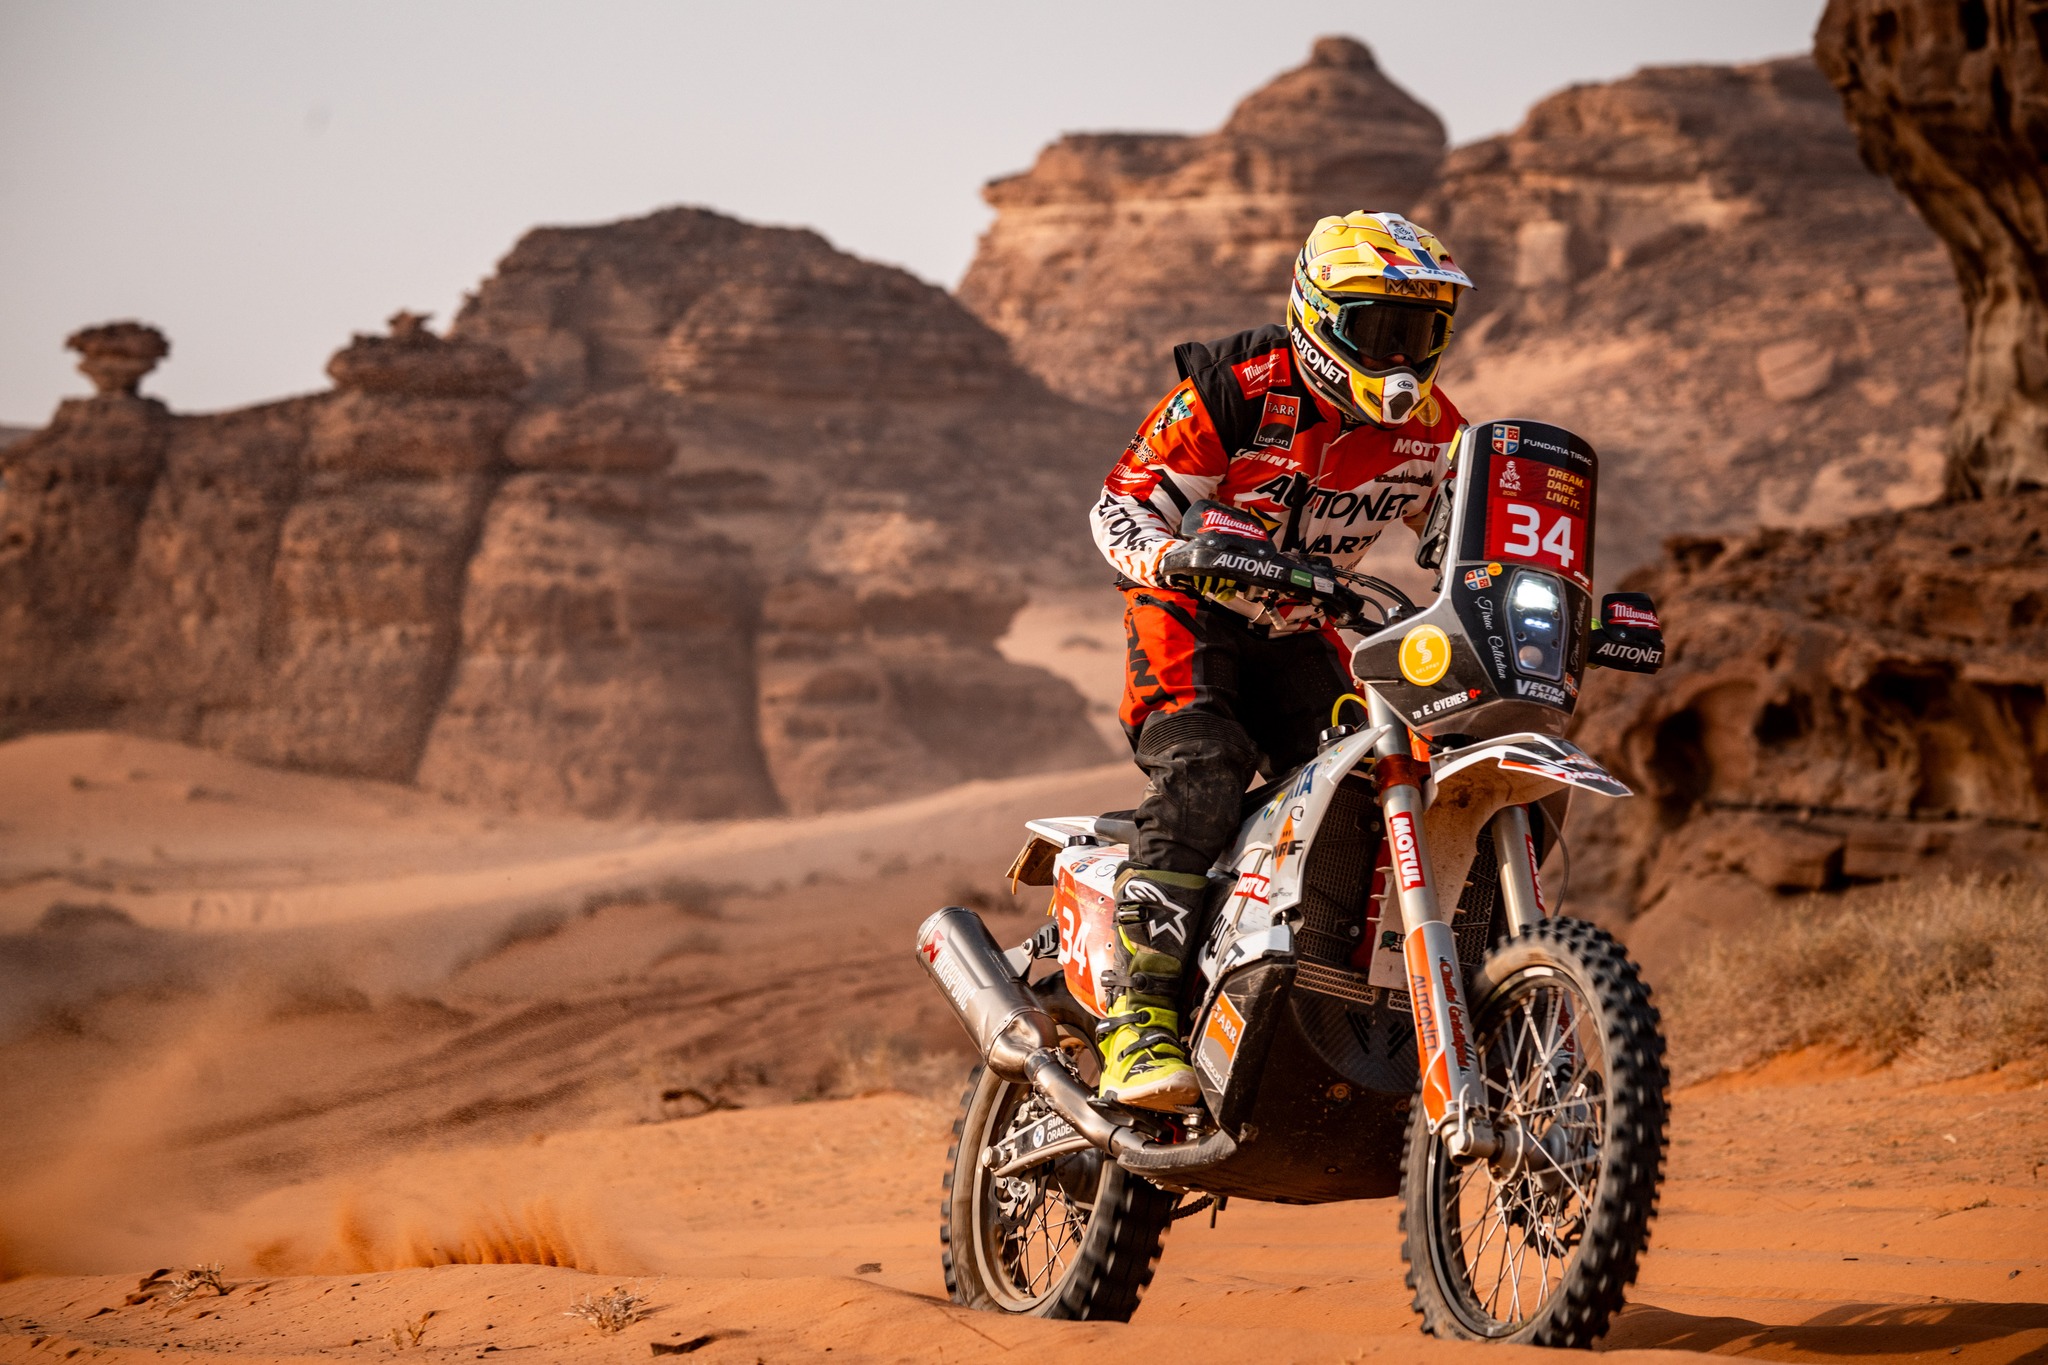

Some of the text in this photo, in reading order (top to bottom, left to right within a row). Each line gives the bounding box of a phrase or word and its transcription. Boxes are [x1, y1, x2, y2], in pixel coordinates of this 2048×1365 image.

[1385, 277, 1438, 299] MANI
[1291, 327, 1348, 384] AUTONET
[1268, 402, 1295, 416] TARR
[1258, 435, 1289, 447] beton
[1392, 438, 1435, 457] MOT
[1546, 479, 1577, 497] DARE.
[1547, 467, 1585, 489] DREAM.
[1545, 490, 1580, 510] LIVE IT.
[1202, 510, 1265, 537] Milwaukee
[1503, 503, 1575, 568] 34
[1212, 553, 1283, 580] AUTONET
[1596, 642, 1663, 664] AUTONET
[1516, 679, 1566, 698] VECTRA
[1422, 704, 1434, 716] E.
[1433, 691, 1468, 712] GYENES
[1392, 817, 1421, 887] MOTUL
[1236, 877, 1270, 899] MOTU
[1060, 905, 1092, 977] 34
[1213, 1003, 1239, 1045] TARR
[1411, 973, 1438, 1052] AUTONET
[1200, 1047, 1224, 1086] beton
